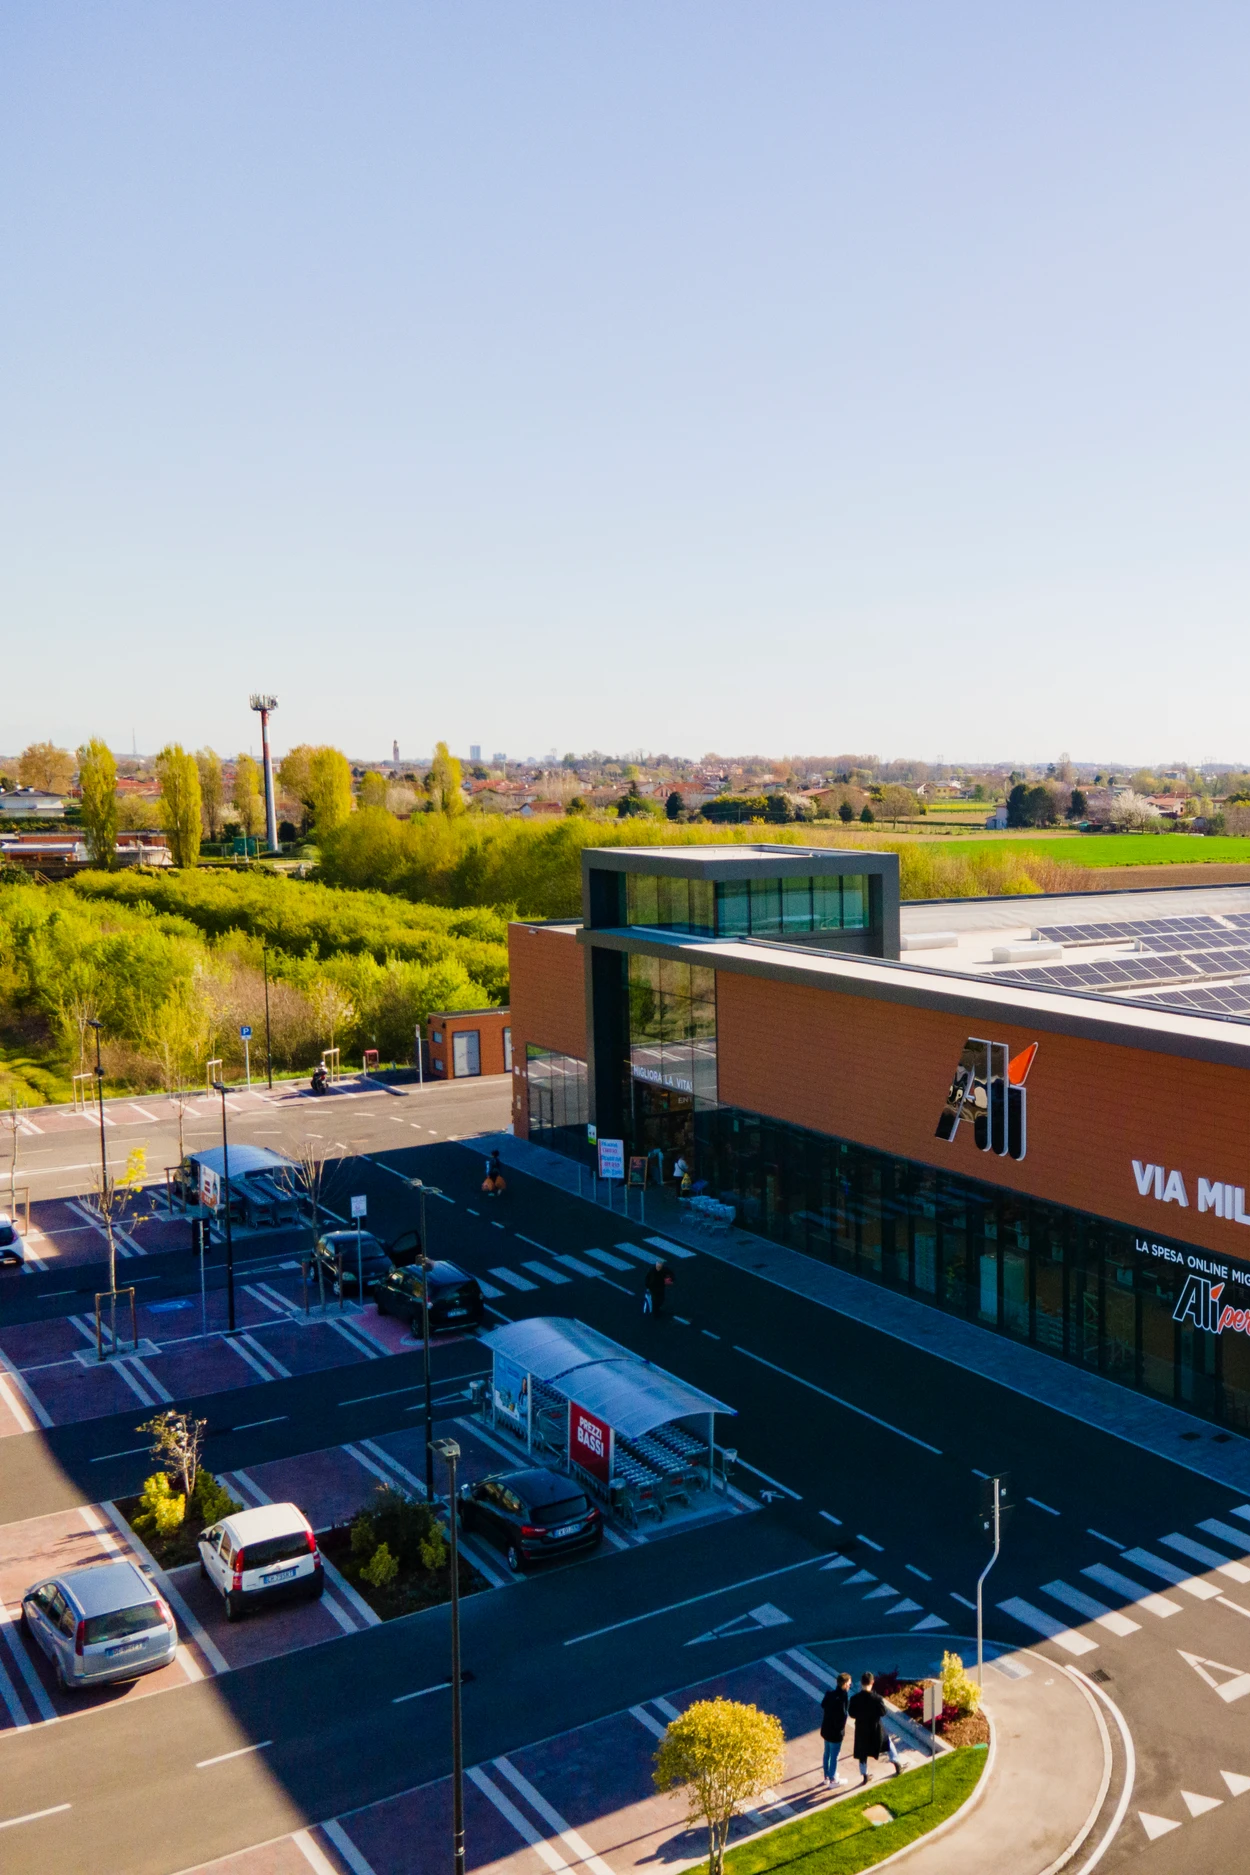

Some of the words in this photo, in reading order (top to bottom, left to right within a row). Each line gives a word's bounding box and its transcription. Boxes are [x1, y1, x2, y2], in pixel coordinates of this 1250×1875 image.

[1131, 1160, 1189, 1208] VIA
[1135, 1239, 1149, 1254] LA
[1151, 1244, 1185, 1265] SPESA
[1187, 1255, 1228, 1279] ONLINE
[577, 1427, 604, 1457] BASSI
[579, 1416, 602, 1440] PREZZI
